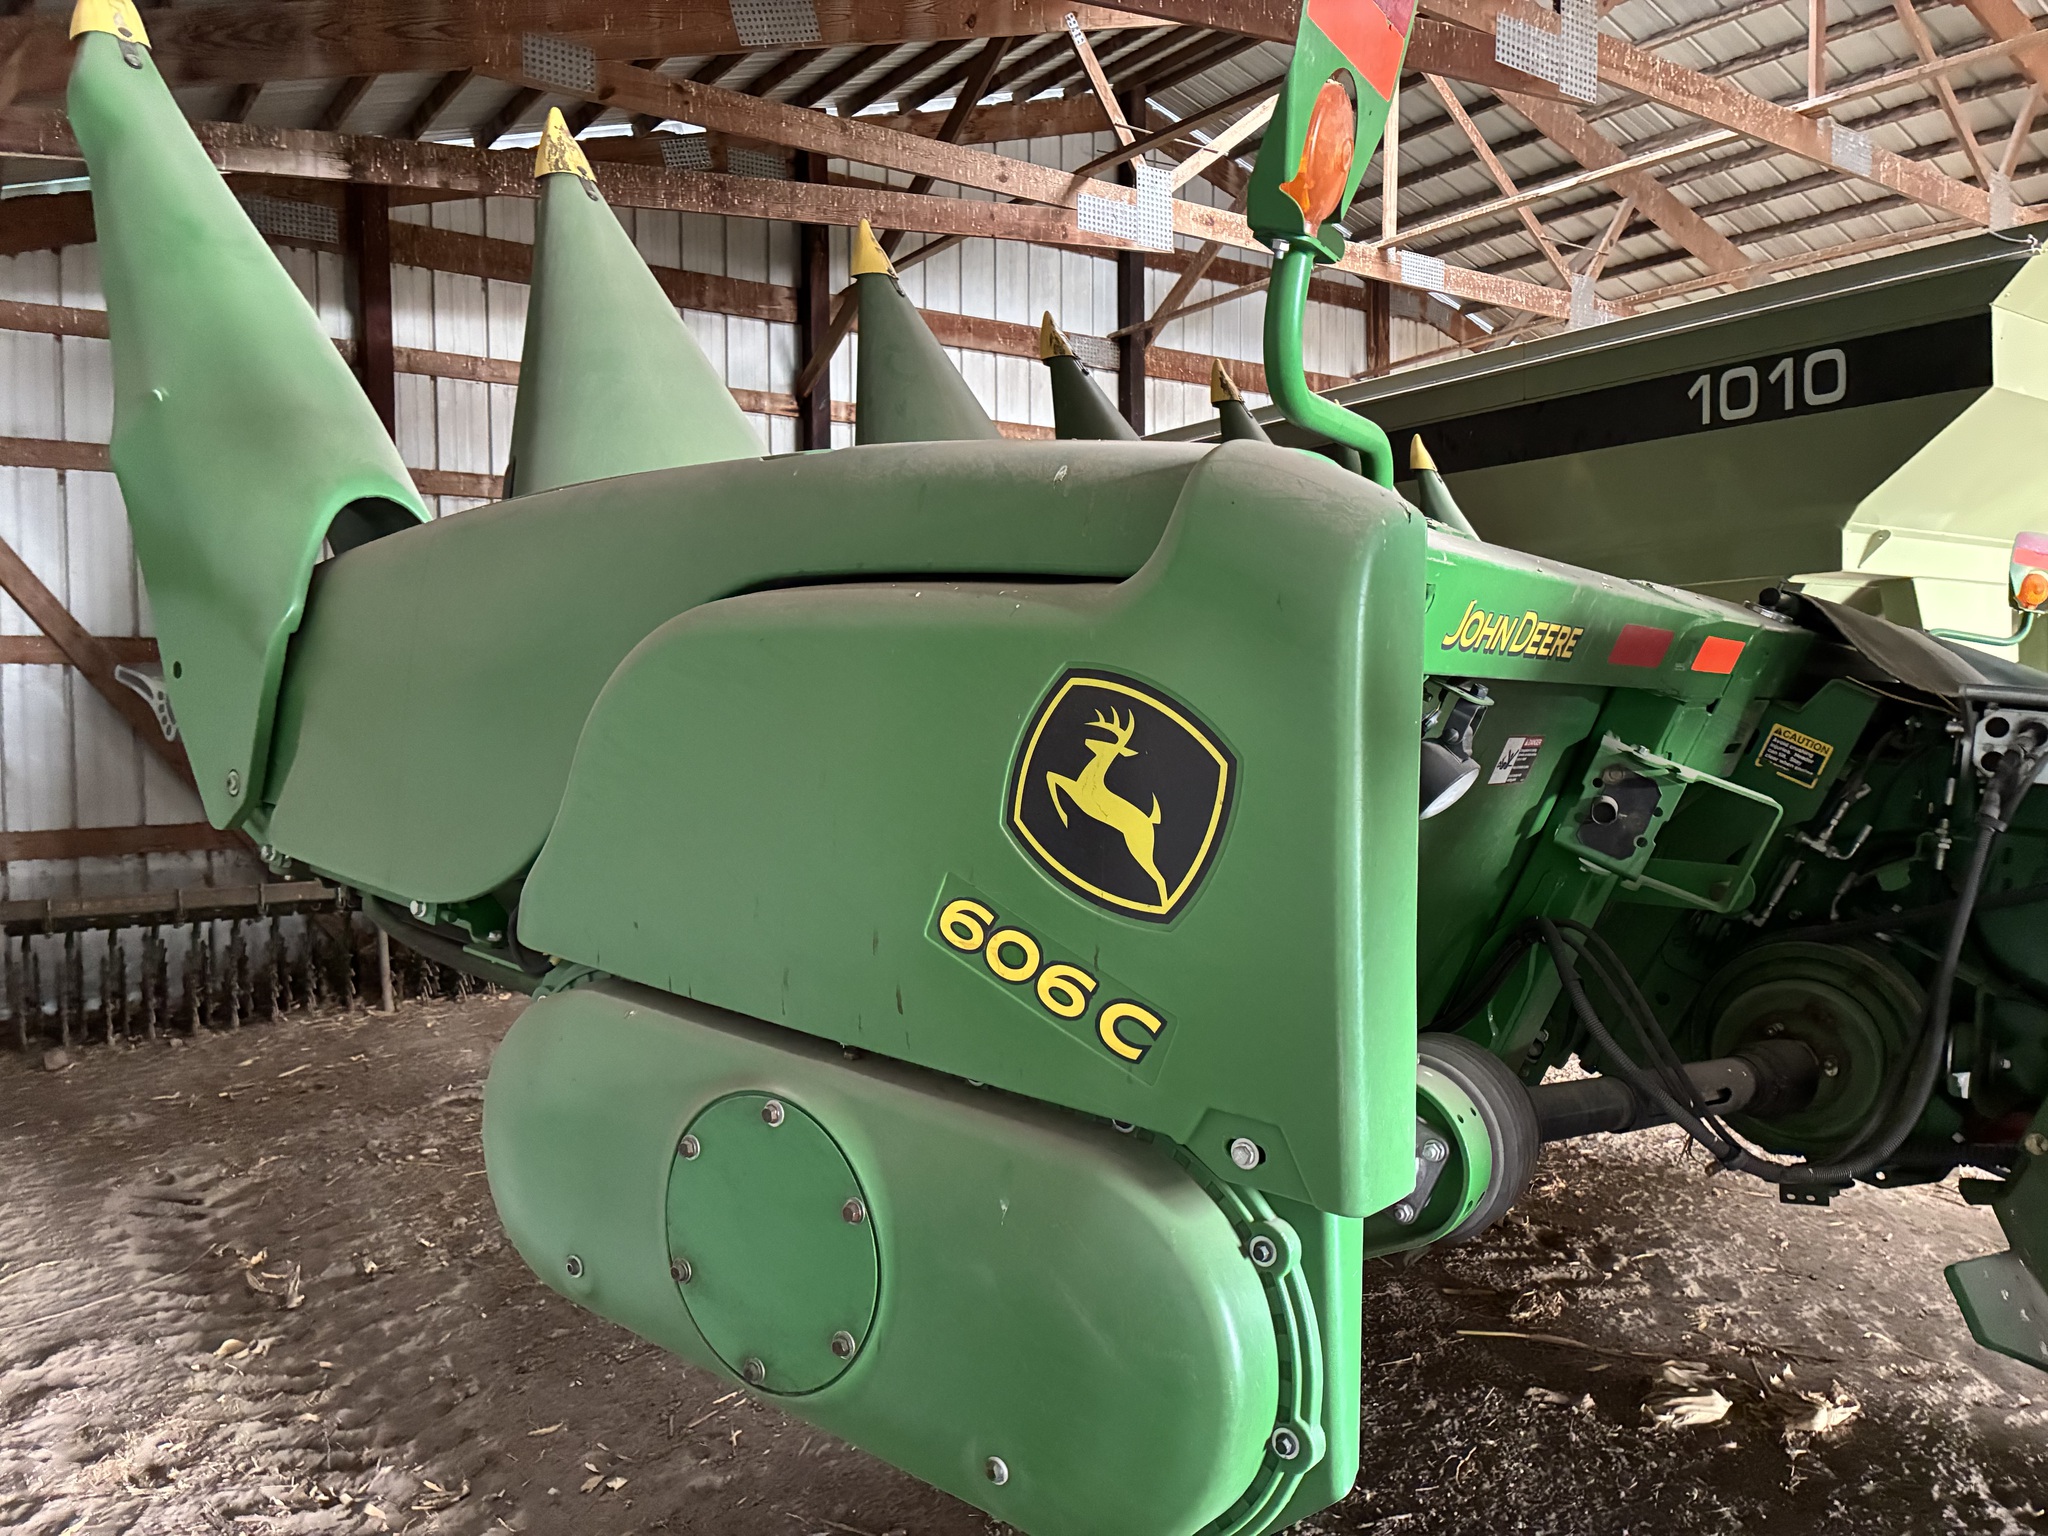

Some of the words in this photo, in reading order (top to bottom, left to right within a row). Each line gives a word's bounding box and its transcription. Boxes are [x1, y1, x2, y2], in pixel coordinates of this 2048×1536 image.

[1687, 349, 1847, 425] 1010
[1441, 599, 1519, 655] JOHN
[1507, 609, 1584, 662] DEERE
[1783, 730, 1830, 754] CAUTION
